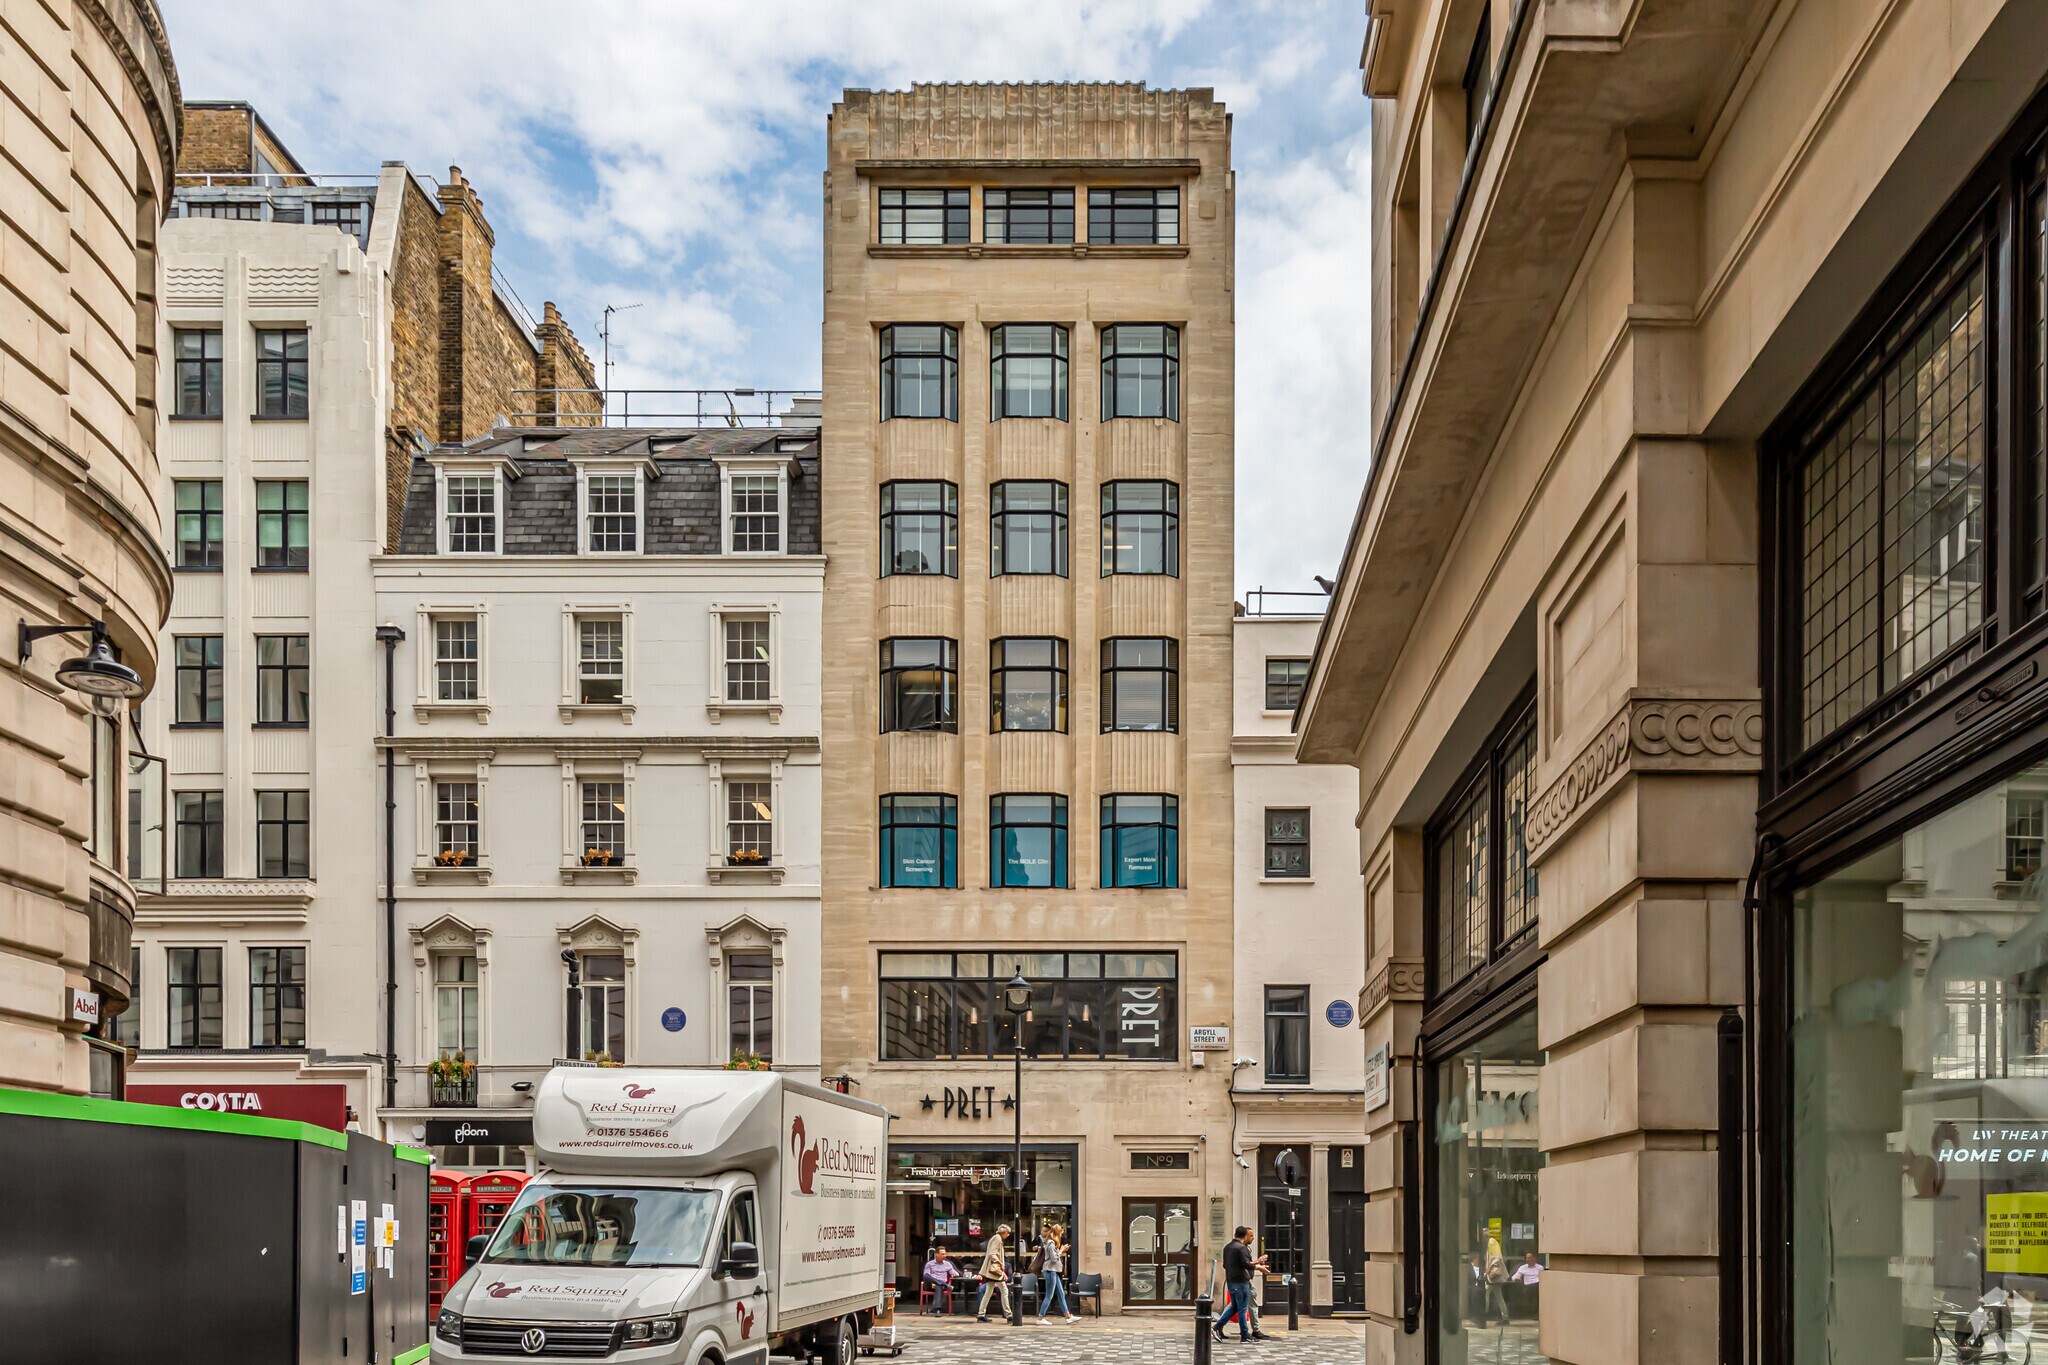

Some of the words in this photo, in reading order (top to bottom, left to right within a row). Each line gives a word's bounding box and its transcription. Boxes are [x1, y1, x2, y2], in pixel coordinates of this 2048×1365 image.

[75, 997, 97, 1016] Abel
[1122, 987, 1160, 1047] PRET
[180, 1092, 262, 1113] COSTA
[589, 1102, 618, 1112] Red
[620, 1103, 677, 1115] Squirrel
[943, 1086, 996, 1119] PRET
[455, 1122, 489, 1144] ploom
[597, 1128, 626, 1137] 01376
[629, 1129, 669, 1138] 554666
[558, 1140, 694, 1151] www.redsquirrelmoves.co.uk
[821, 1137, 841, 1171] Red
[843, 1141, 876, 1183] Squirrel
[1938, 1148, 2002, 1163] HOME
[2007, 1148, 2037, 1163] OF
[822, 1226, 838, 1240] 01376
[838, 1225, 855, 1239] 554666
[802, 1243, 867, 1263] www.redsquirrelmoves.co.uk
[528, 1284, 560, 1294] Red
[562, 1285, 628, 1297] Squirrel
